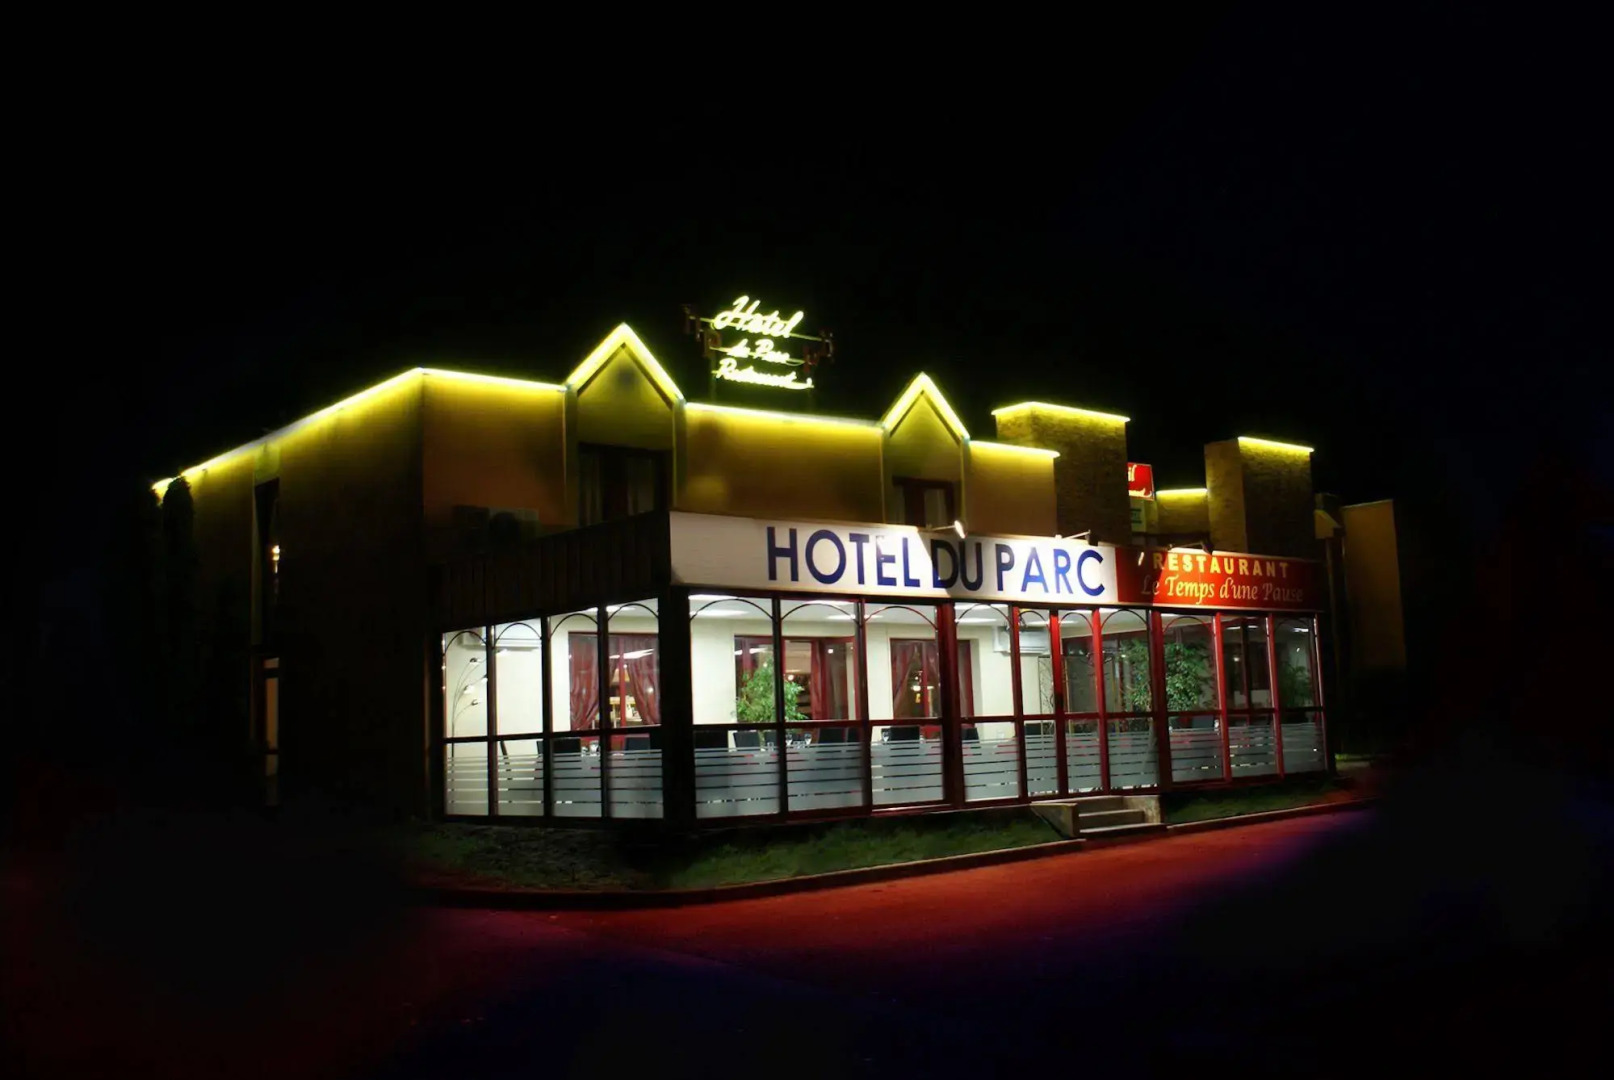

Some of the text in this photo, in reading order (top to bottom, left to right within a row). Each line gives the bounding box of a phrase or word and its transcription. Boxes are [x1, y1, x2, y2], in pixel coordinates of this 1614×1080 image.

[713, 294, 805, 338] Hotel
[766, 525, 1105, 597] HOTEL DU PARC
[1153, 553, 1289, 579] RESTAURANT
[1141, 575, 1304, 605] Le Temps d'une Pause
